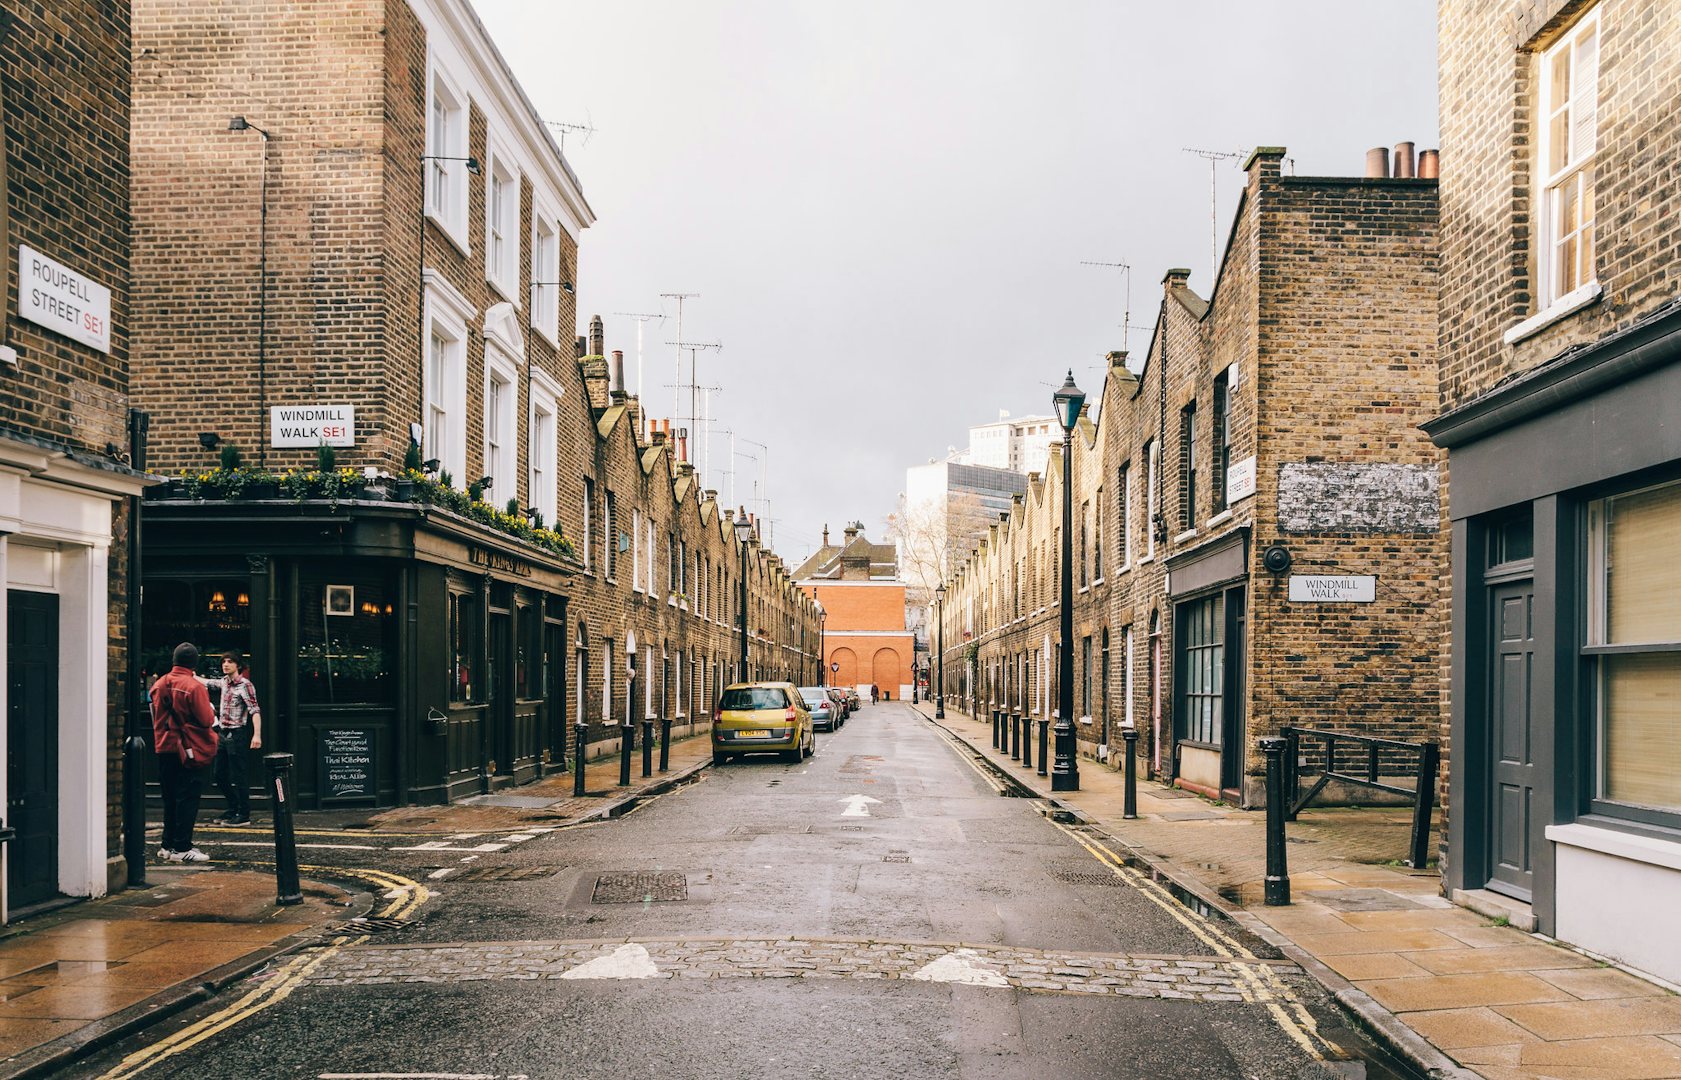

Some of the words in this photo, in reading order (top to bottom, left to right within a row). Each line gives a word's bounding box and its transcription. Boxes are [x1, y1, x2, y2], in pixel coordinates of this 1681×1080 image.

[33, 259, 91, 303] ROUPELL
[32, 288, 81, 325] STREET
[83, 313, 103, 336] SE1
[280, 410, 344, 421] WINDMILL
[280, 427, 319, 438] WALK
[323, 427, 346, 437] SE1
[1229, 480, 1244, 495] STREET
[470, 545, 489, 566] THE
[490, 552, 514, 572] KINGS
[514, 558, 532, 577] ARMS
[1305, 579, 1358, 589] WINDMILL
[1311, 589, 1340, 598] WALK
[324, 756, 340, 764] Thai
